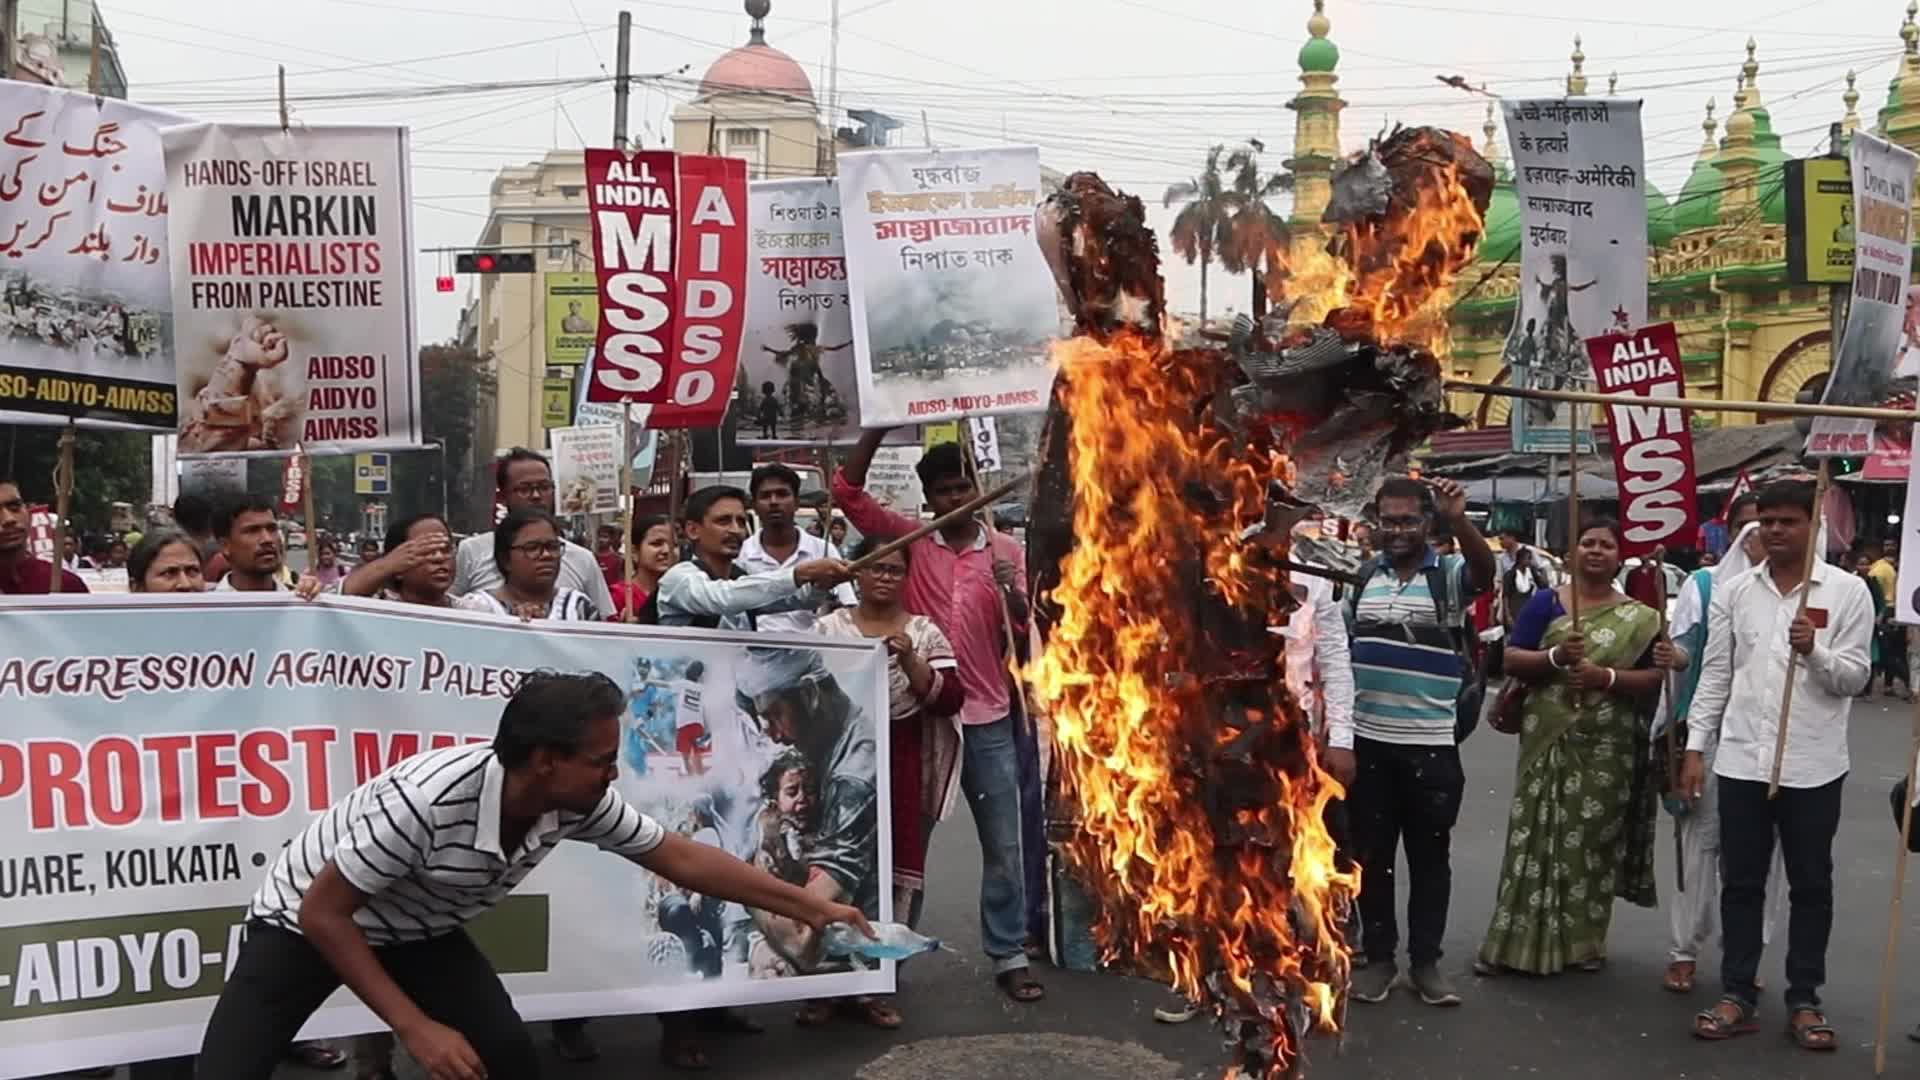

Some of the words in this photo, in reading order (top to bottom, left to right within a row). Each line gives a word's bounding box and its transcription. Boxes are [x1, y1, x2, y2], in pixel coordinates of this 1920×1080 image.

[3, 110, 47, 149] کے
[1518, 131, 1532, 152] के
[62, 121, 129, 173] جنگ
[0, 154, 39, 202] کی
[38, 170, 97, 207] امن
[184, 159, 299, 187] HANDS-OFF
[304, 160, 377, 187] ISRAEL
[606, 160, 657, 184] ALL
[596, 184, 671, 209] INDIA
[231, 194, 377, 237] MARKIN
[67, 221, 111, 263] بلند
[189, 241, 382, 276] IMPERIALISTS
[900, 244, 969, 271] নিপাত
[973, 247, 1014, 268] যাক
[760, 256, 848, 288] সাম্রাজ্য
[191, 281, 253, 310] FROM
[258, 280, 383, 310] PALESTINE
[596, 210, 673, 394] MSS
[674, 185, 737, 406] AIDSO
[778, 287, 835, 311] নিপাত
[308, 355, 376, 380] AIDSO
[1611, 337, 1661, 364] ALL
[1603, 356, 1677, 389] INDIA
[0, 373, 175, 415] SO-AIDYO-AIMSS
[309, 386, 377, 411] AIDYO
[908, 389, 1040, 417] AIDSO-AIDYO-AIMSS
[304, 415, 379, 442] AIMSS
[1608, 380, 1688, 544] MSS
[1, 652, 255, 702] AGGRESSION
[266, 651, 411, 690] AGAINST
[0, 729, 337, 830] PROTEST
[0, 853, 96, 901] UARE,
[106, 843, 242, 889] KOLKATA
